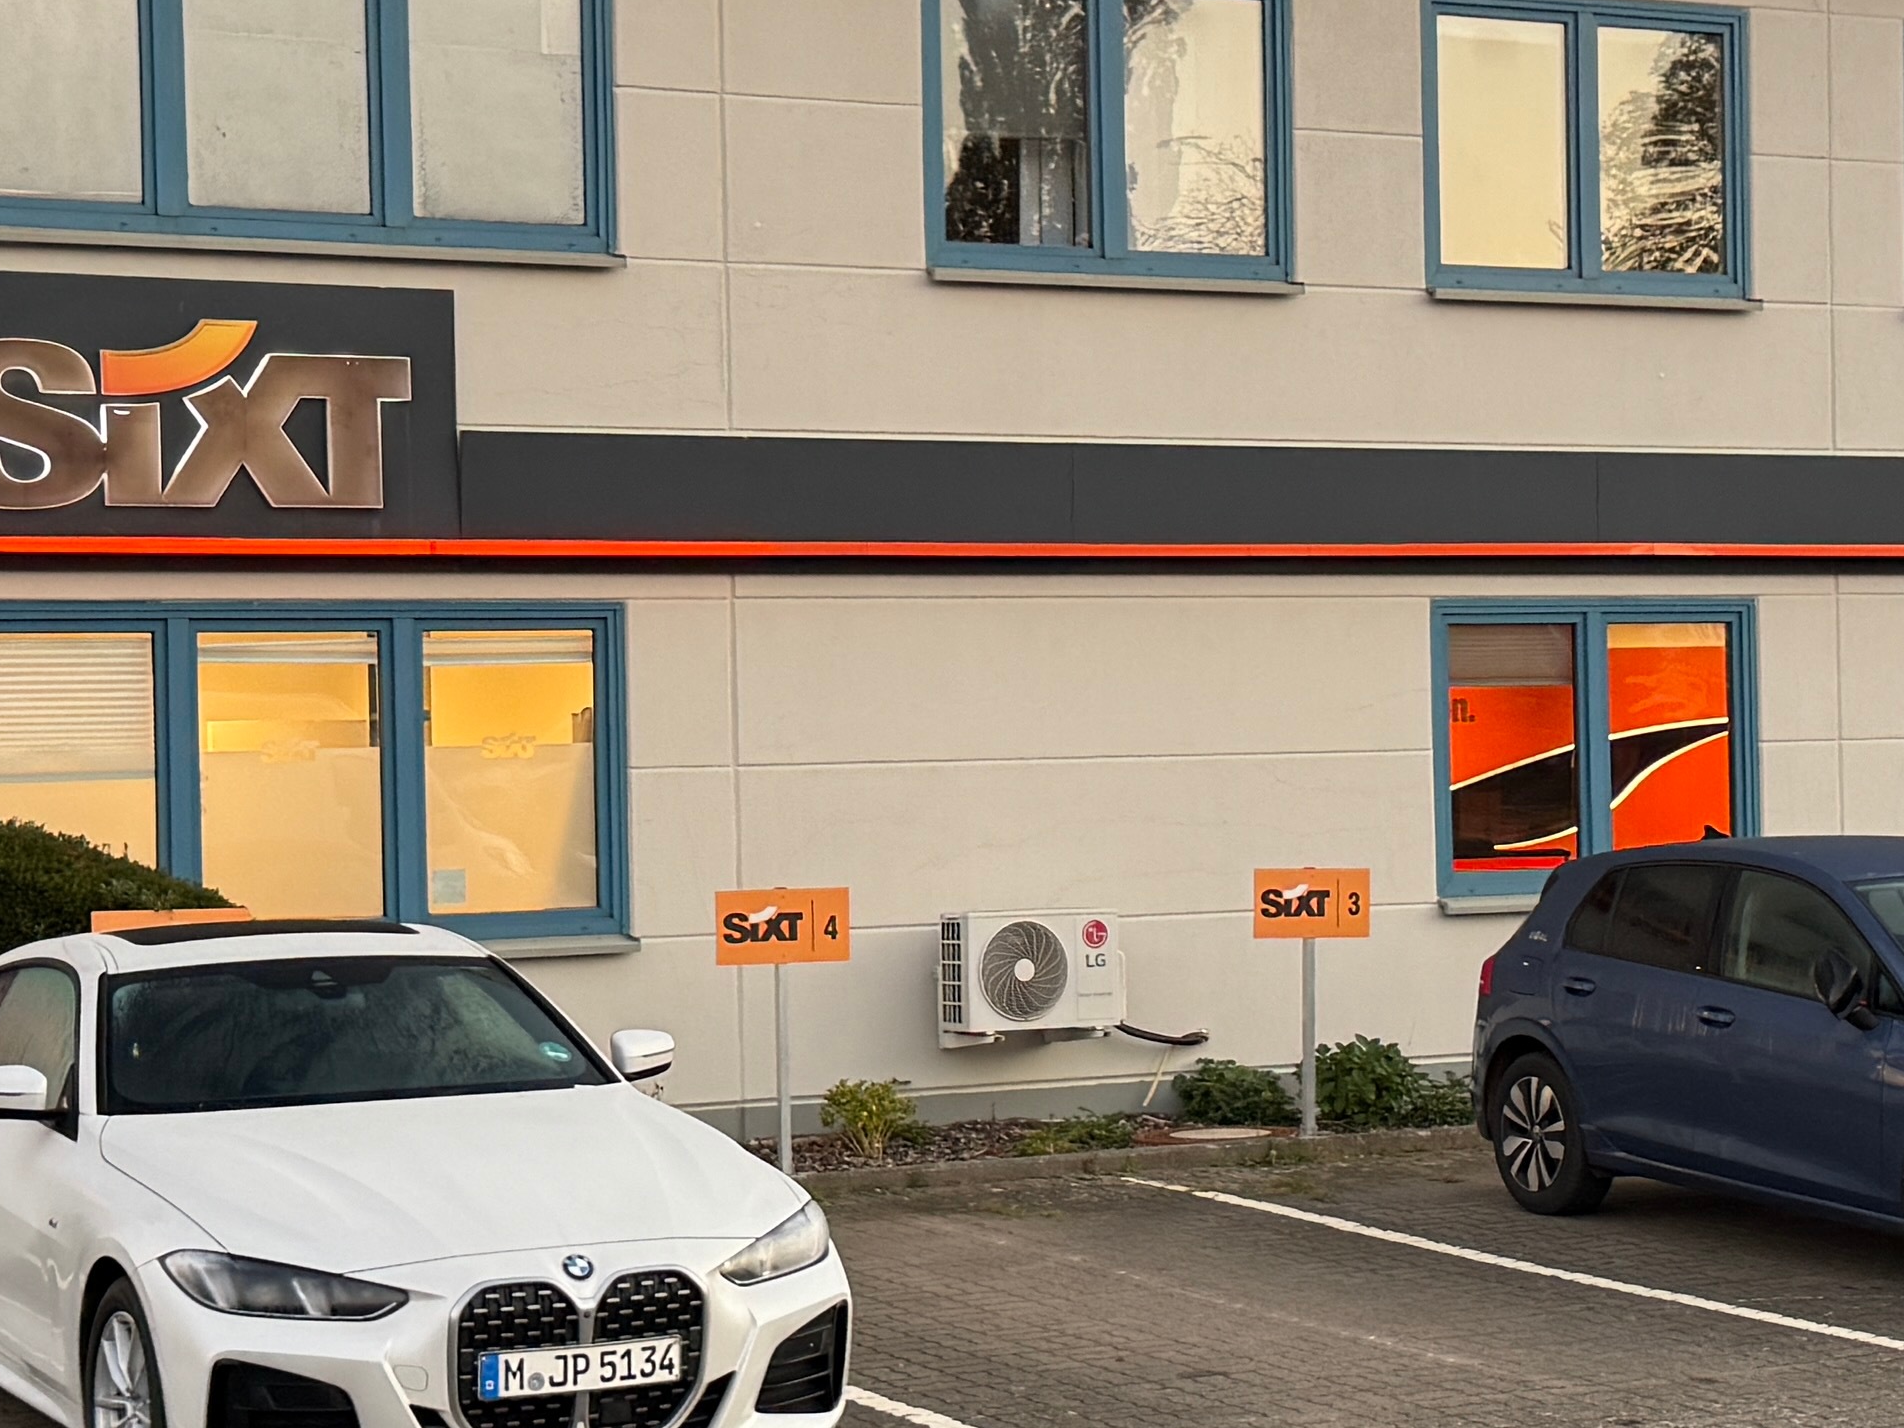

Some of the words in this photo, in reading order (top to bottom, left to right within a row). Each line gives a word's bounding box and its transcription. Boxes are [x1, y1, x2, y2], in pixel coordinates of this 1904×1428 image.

[1348, 892, 1360, 916] 3
[824, 915, 838, 940] 4
[1085, 953, 1106, 968] LG
[549, 1353, 590, 1387] JP
[600, 1341, 676, 1382] 5134
